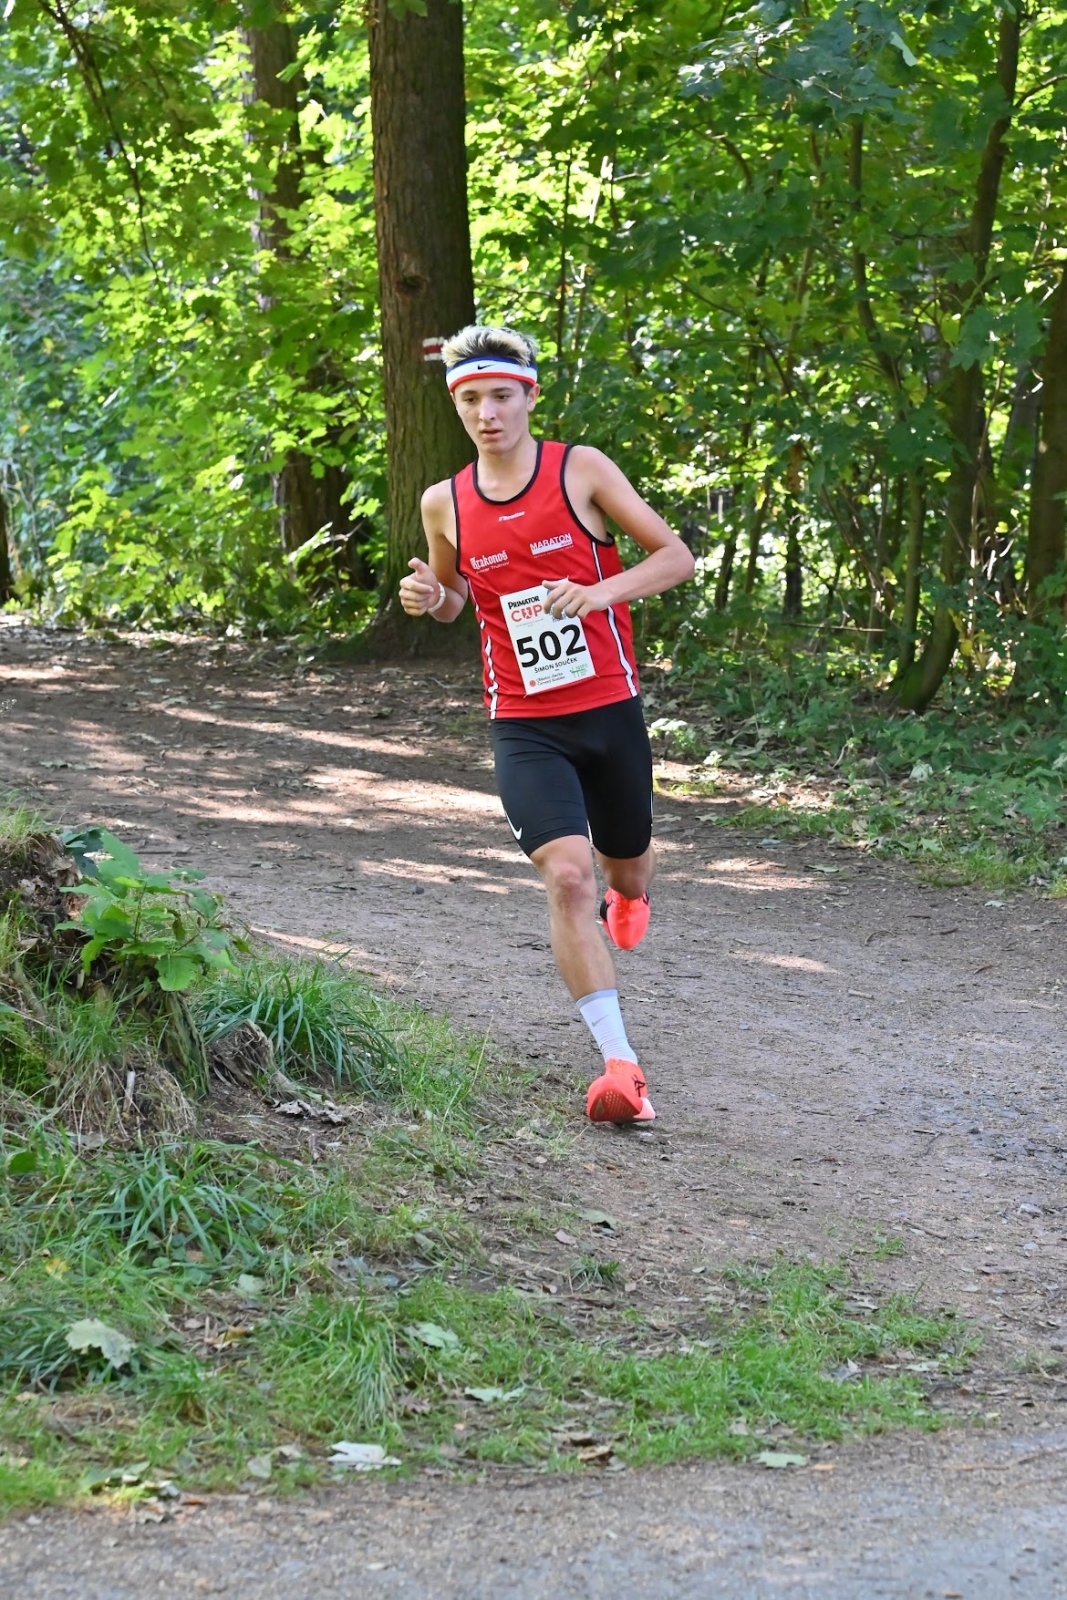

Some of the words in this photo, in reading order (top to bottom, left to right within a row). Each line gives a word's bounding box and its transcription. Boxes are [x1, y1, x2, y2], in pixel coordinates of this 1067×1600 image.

[530, 533, 570, 550] MARATON
[508, 596, 540, 609] PRIMATOR
[511, 604, 543, 622] CUP
[516, 624, 587, 668] 502
[534, 664, 554, 674] ŠIMON
[555, 657, 578, 667] SOUČEK
